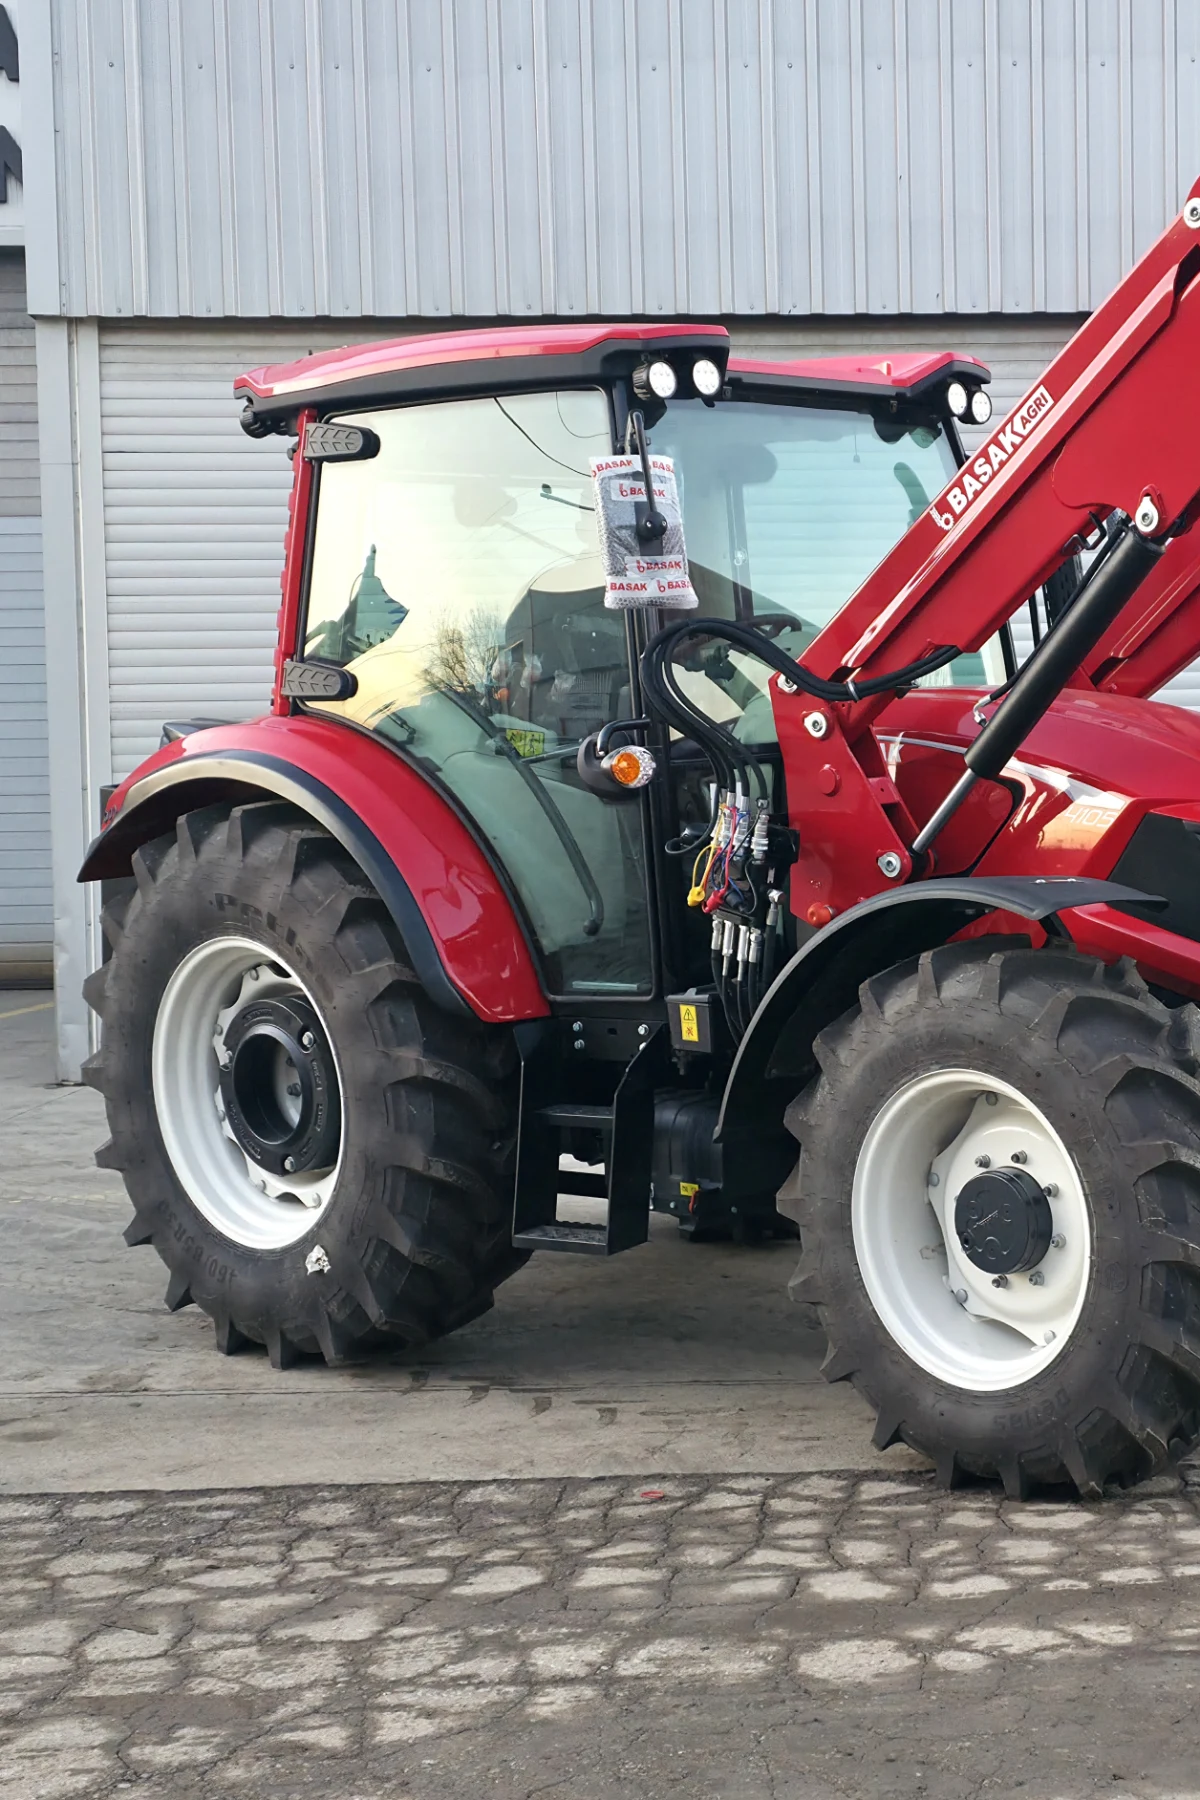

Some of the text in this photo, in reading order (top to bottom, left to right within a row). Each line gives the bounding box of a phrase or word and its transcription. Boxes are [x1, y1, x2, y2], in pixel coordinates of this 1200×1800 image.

[946, 392, 1049, 515] BASAK AGRI
[629, 487, 666, 498] BAAK
[646, 561, 682, 571] BASAK
[610, 582, 648, 592] BASAK
[1064, 806, 1117, 828] 4105
